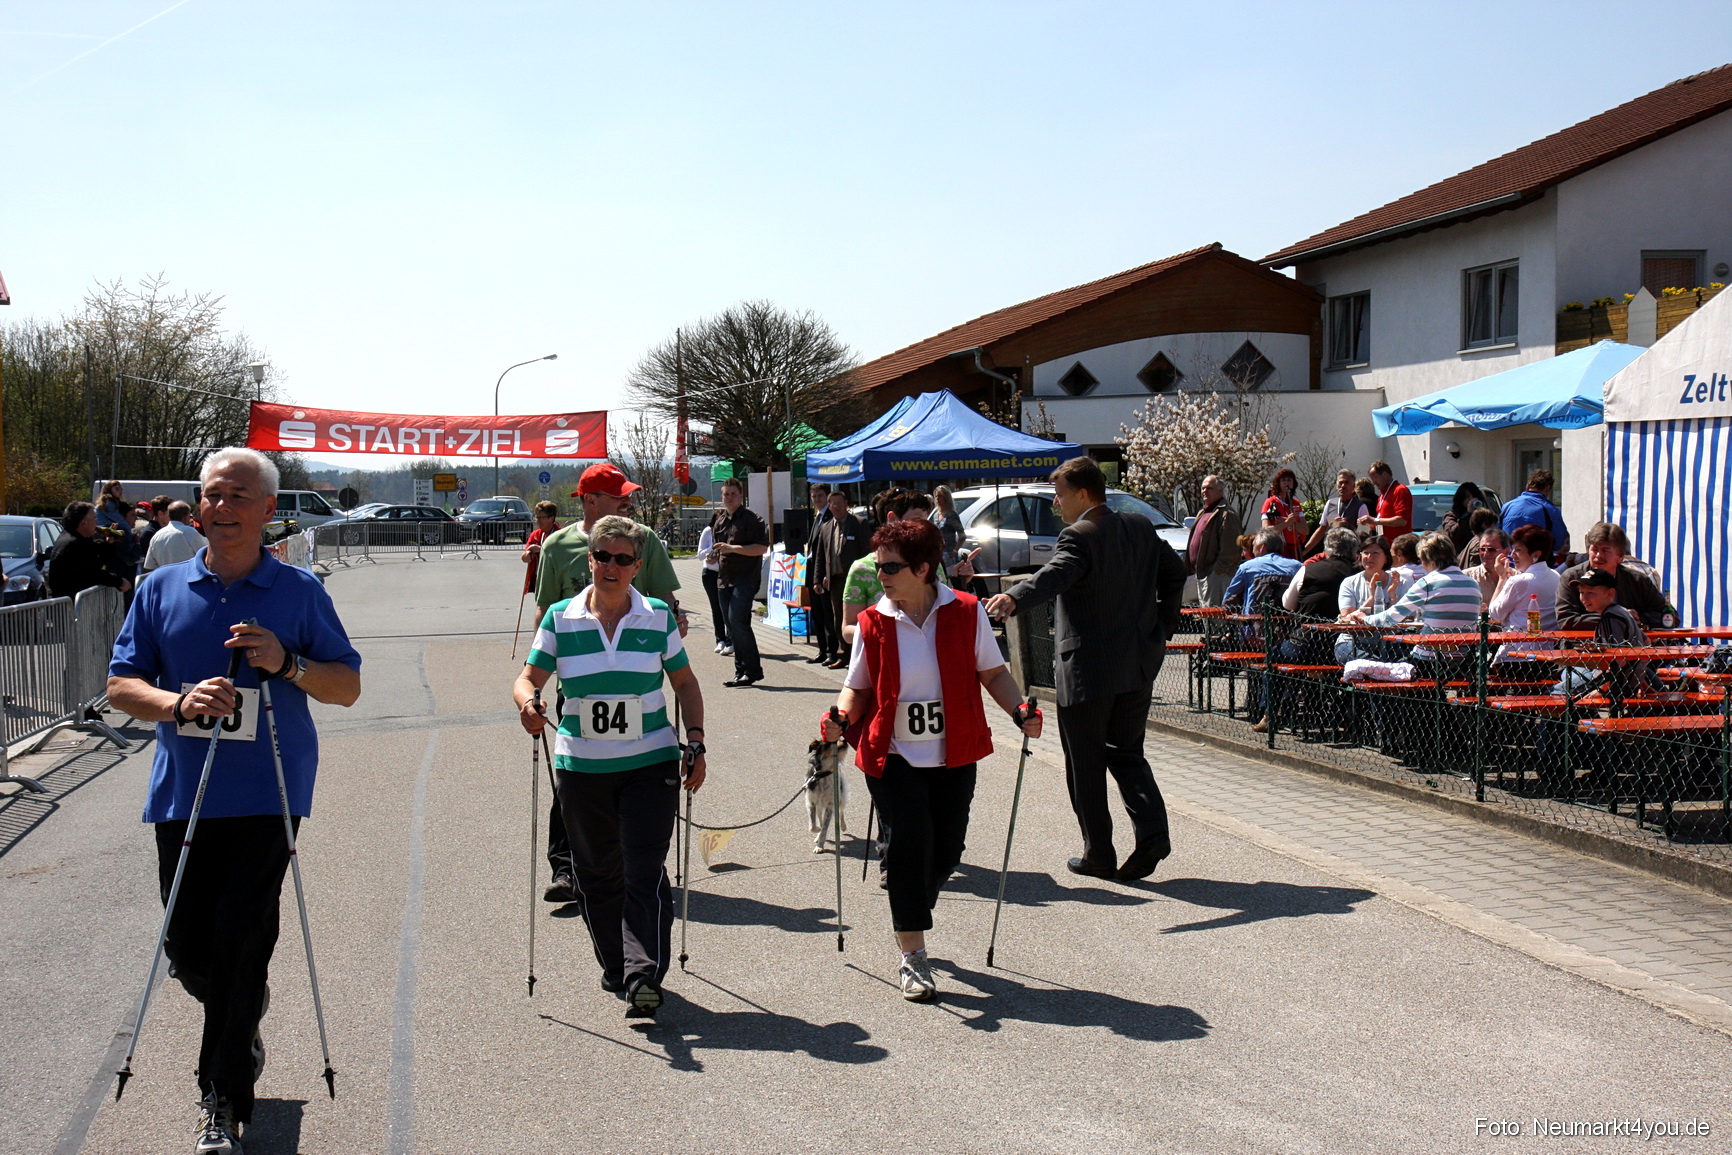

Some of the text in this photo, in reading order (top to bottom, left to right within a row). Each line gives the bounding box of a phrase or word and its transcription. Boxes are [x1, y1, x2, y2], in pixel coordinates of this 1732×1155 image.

[1680, 373, 1732, 404] Zelt
[890, 455, 1059, 471] www.emmanet.com
[592, 700, 628, 734] 84
[907, 701, 944, 735] 85
